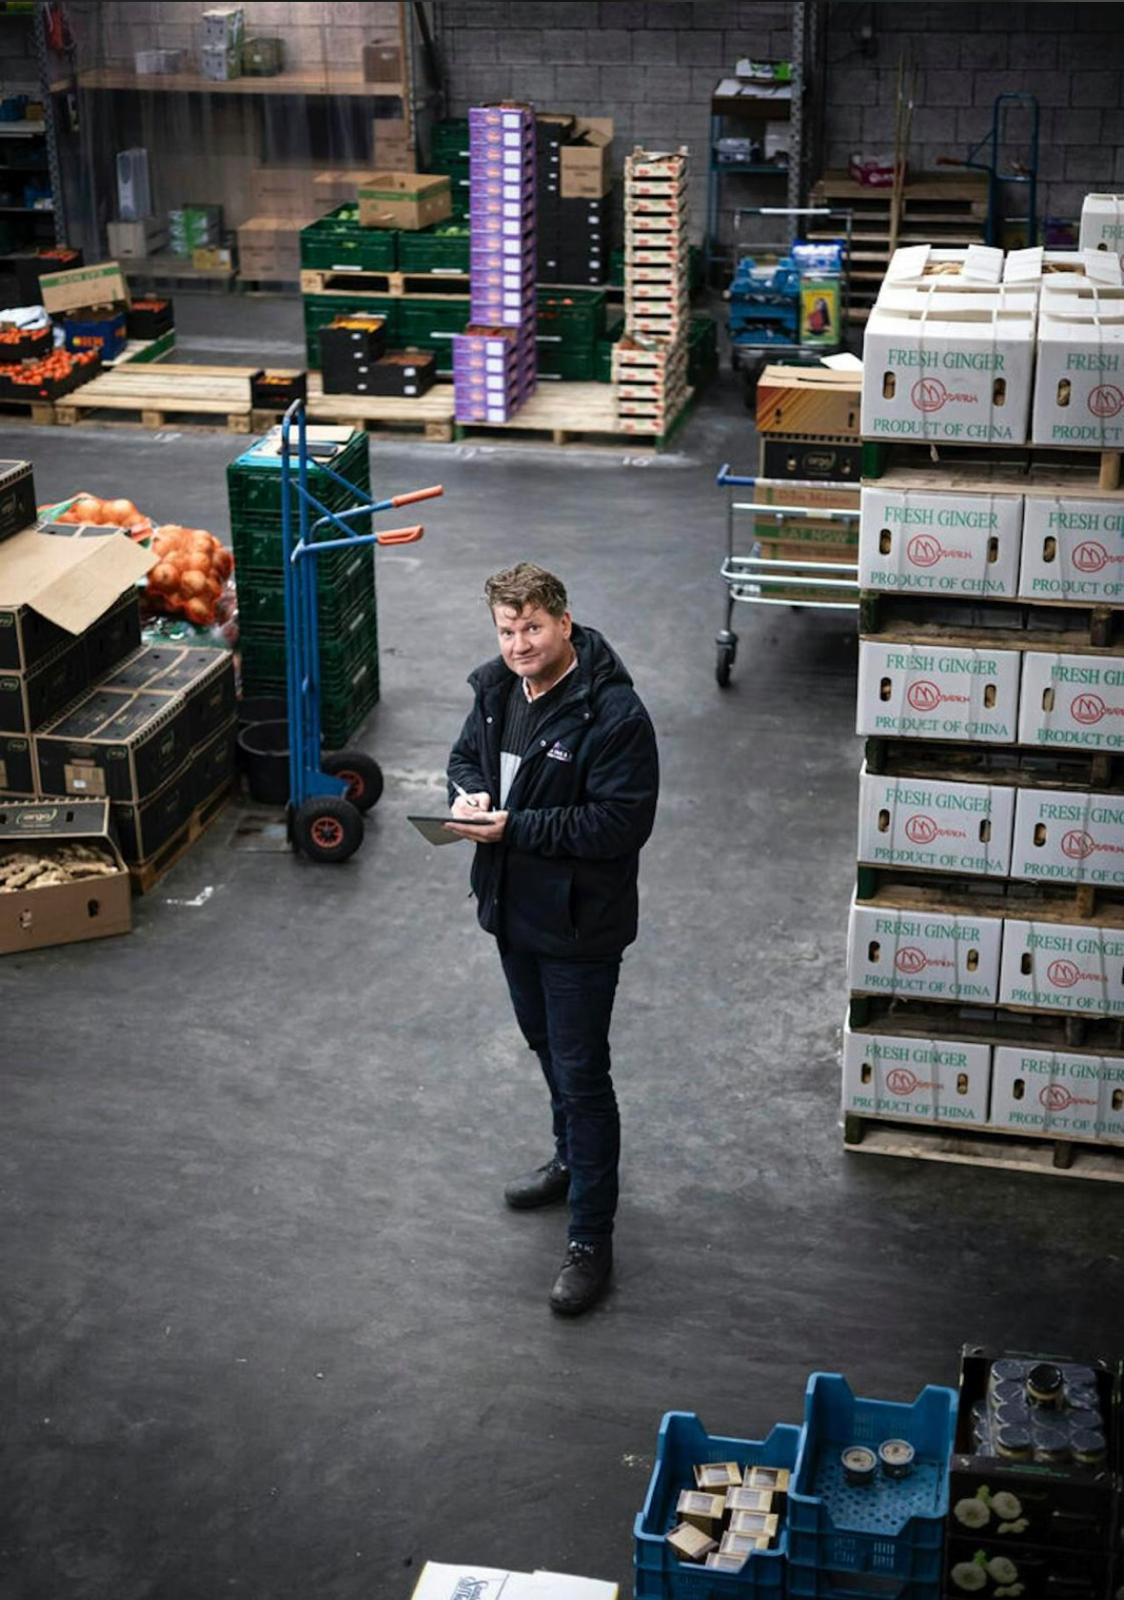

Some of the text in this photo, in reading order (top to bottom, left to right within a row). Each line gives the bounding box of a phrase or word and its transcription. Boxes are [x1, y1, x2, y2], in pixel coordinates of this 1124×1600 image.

[888, 349, 1005, 371] FRESH GINGER
[1066, 353, 1120, 371] FRESH
[873, 418, 1012, 439] PRODUCT OF CHINA
[1052, 425, 1121, 441] PRODUCT
[884, 506, 998, 529] FRESH GINGER
[1049, 512, 1099, 530] FRESH
[871, 571, 1005, 592] PRODUCT OF CHINA
[1032, 578, 1123, 595] PRODUCT OF
[886, 654, 997, 676] FRESH GINGER
[1052, 665, 1100, 684] FRESH
[875, 716, 1008, 736] PRODUCT OF CHINA
[1037, 728, 1124, 747] PRODUCT OF
[885, 788, 992, 812] FRESH GINGER
[1039, 803, 1088, 821] FRESH
[875, 847, 1004, 872] PRODUCT OF CHINA
[1024, 862, 1088, 879] PRODUCT
[1091, 867, 1111, 882] OF
[875, 919, 980, 942] FRESH GINGER
[1026, 933, 1074, 951] FRESH
[865, 974, 990, 997] PRODUCT OF CHINA
[1011, 989, 1074, 1006] PRODUCT
[1077, 996, 1094, 1009] OF
[865, 1044, 967, 1067] FRESH GINGER
[1020, 1058, 1066, 1076] FRESH
[853, 1097, 975, 1120] PRODUCT OF CHINA
[1009, 1112, 1068, 1128] PRODUCT
[1073, 1119, 1089, 1131] OF
